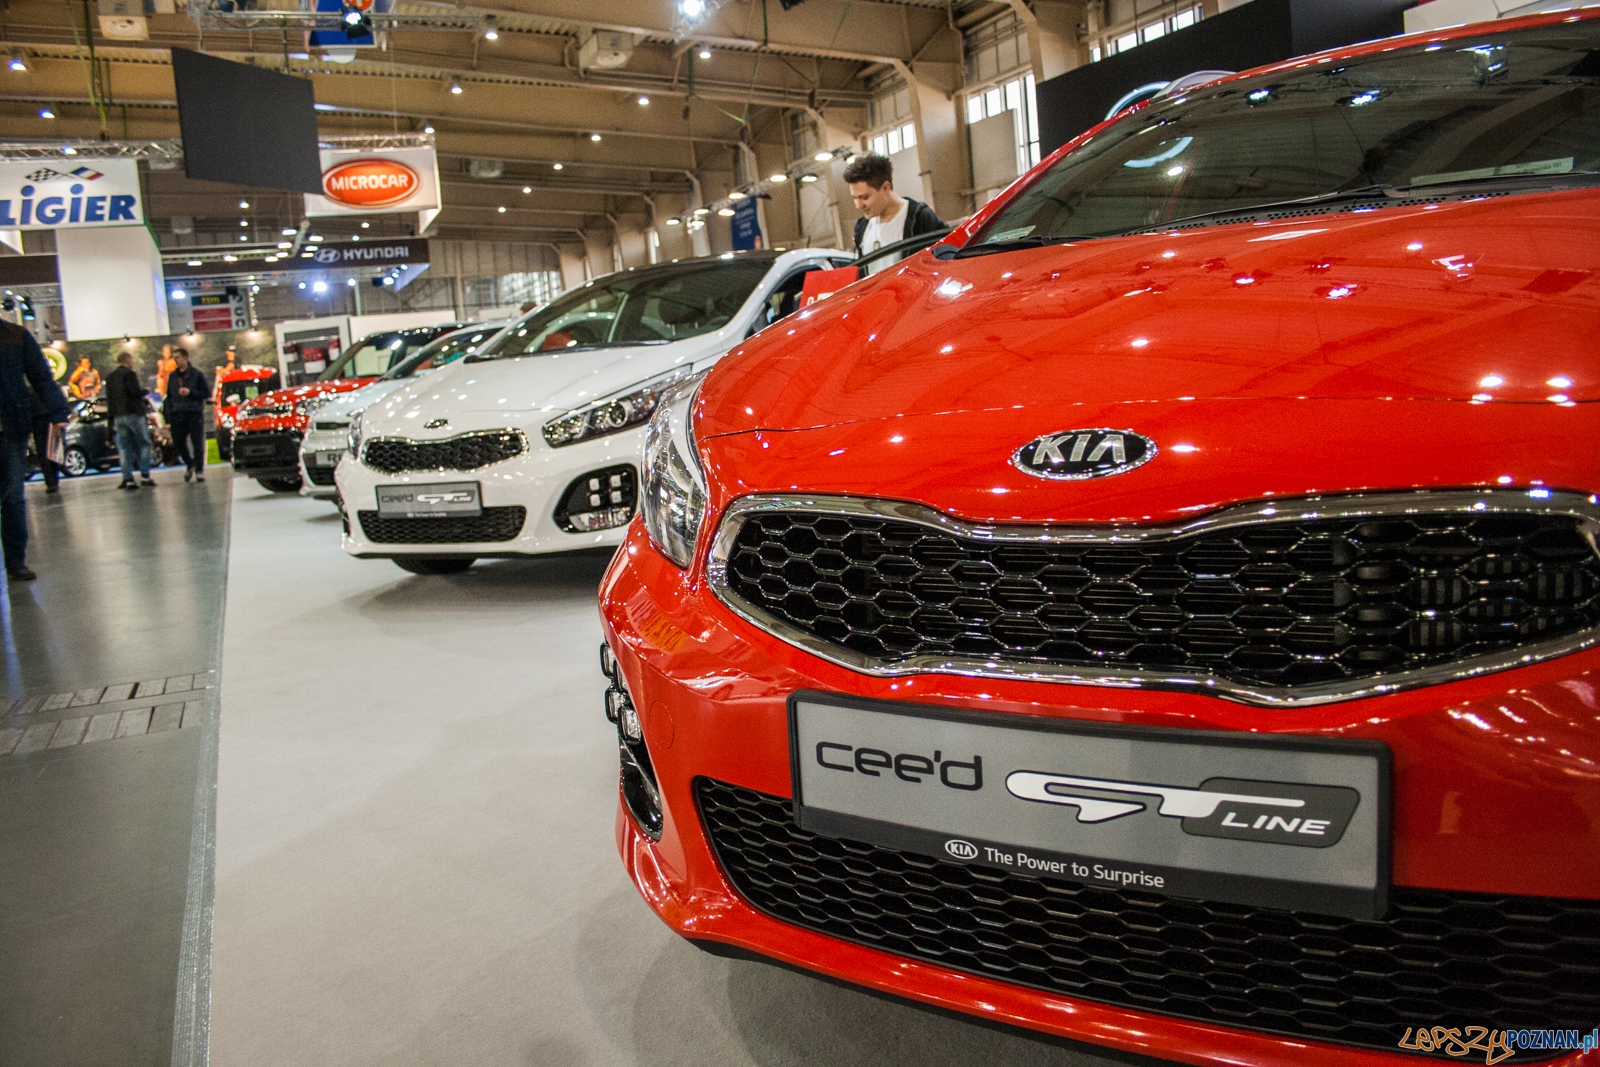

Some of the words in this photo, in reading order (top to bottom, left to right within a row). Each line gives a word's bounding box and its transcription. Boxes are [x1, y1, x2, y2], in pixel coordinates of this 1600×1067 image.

[331, 173, 409, 191] MICROCAR
[342, 246, 410, 261] HYUNDAI
[1032, 433, 1127, 465] KIA
[816, 741, 983, 791] cee'd
[1221, 811, 1331, 836] LINE
[949, 842, 974, 858] KIA
[984, 846, 1013, 866] The
[1017, 852, 1067, 874] Power
[1071, 861, 1089, 878] to
[1093, 864, 1165, 888] Surprise
